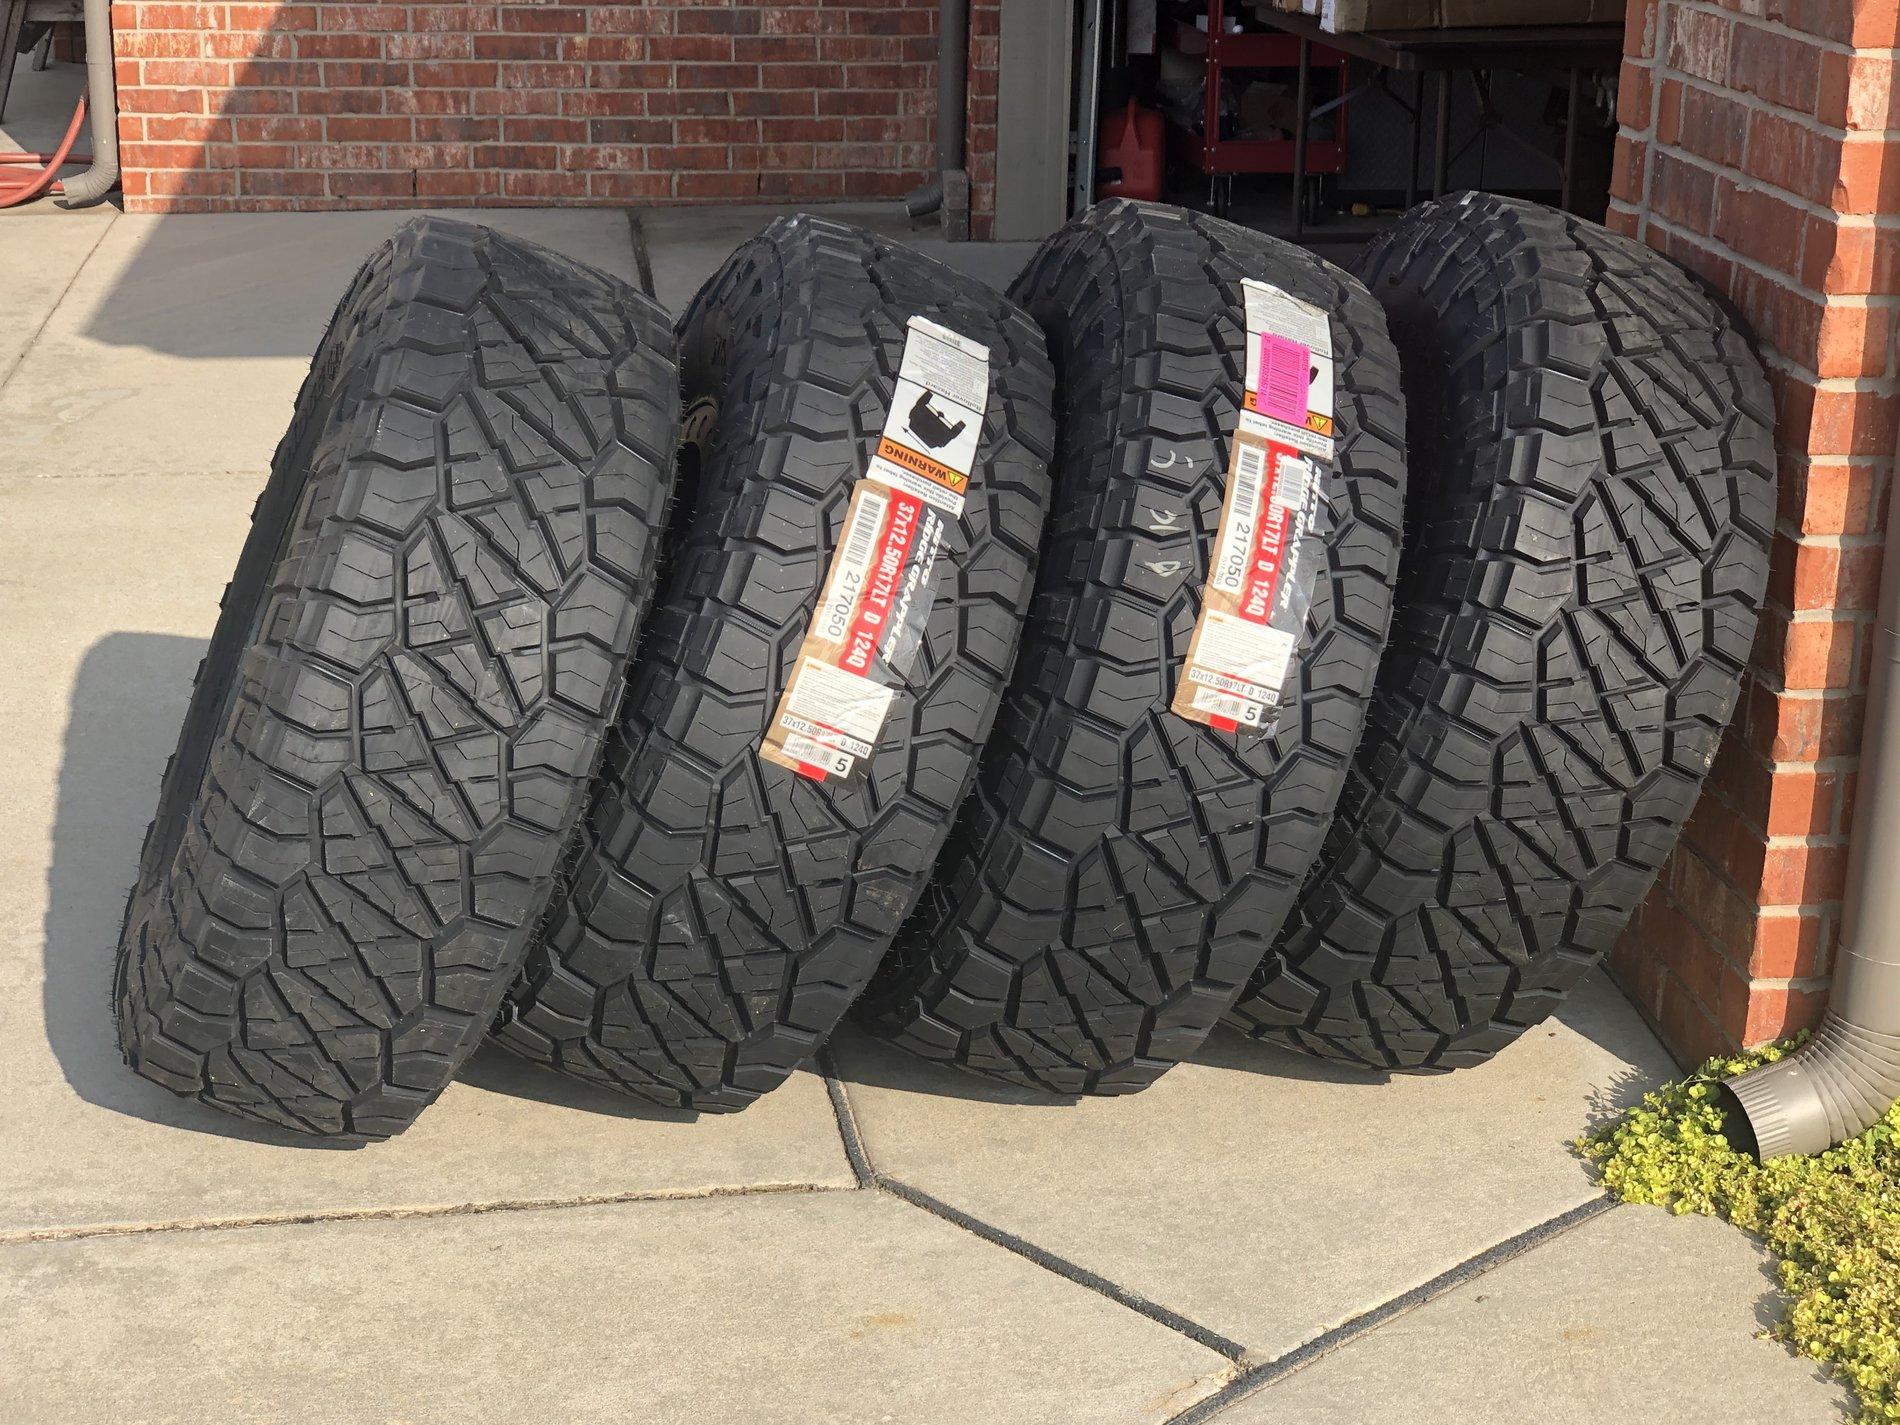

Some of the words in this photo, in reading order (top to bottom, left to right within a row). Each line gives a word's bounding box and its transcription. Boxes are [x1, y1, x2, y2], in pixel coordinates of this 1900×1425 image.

[884, 444, 947, 480] WARNING
[869, 501, 915, 607] 37x12.50R17LT
[915, 508, 937, 565] RIDGE
[1225, 522, 1251, 588] 217050
[1257, 559, 1275, 573] D
[1280, 511, 1306, 609] GRAPPLER
[827, 571, 861, 637] 217050
[882, 564, 920, 664] GRAPPLER
[1244, 580, 1271, 617] 124Q
[863, 612, 882, 625] D
[845, 630, 874, 669] 124Q
[782, 715, 836, 743] 37x12.50R
[1244, 706, 1257, 721] 5
[835, 758, 848, 772] 5
